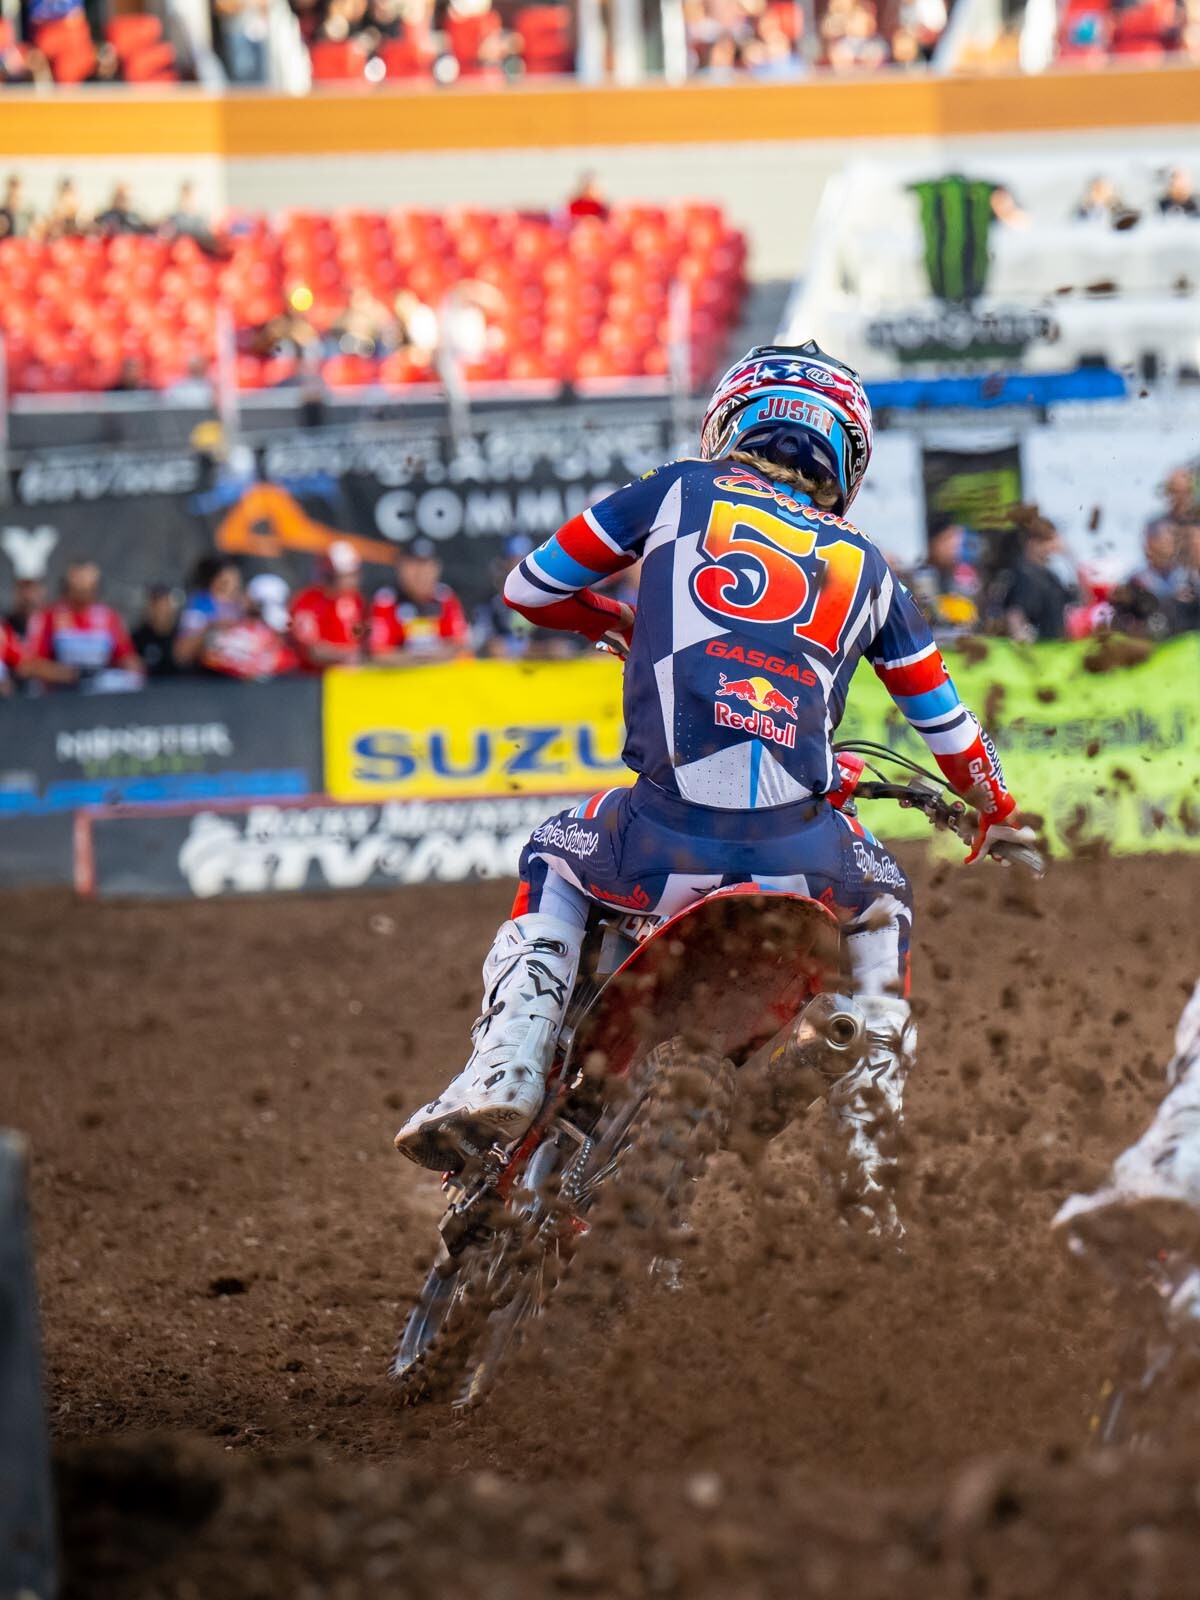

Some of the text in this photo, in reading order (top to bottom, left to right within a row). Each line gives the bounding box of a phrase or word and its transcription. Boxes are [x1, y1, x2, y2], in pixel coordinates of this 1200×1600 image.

[694, 500, 866, 658] 51
[705, 640, 817, 688] GASGAS
[714, 701, 797, 749] Red Bull
